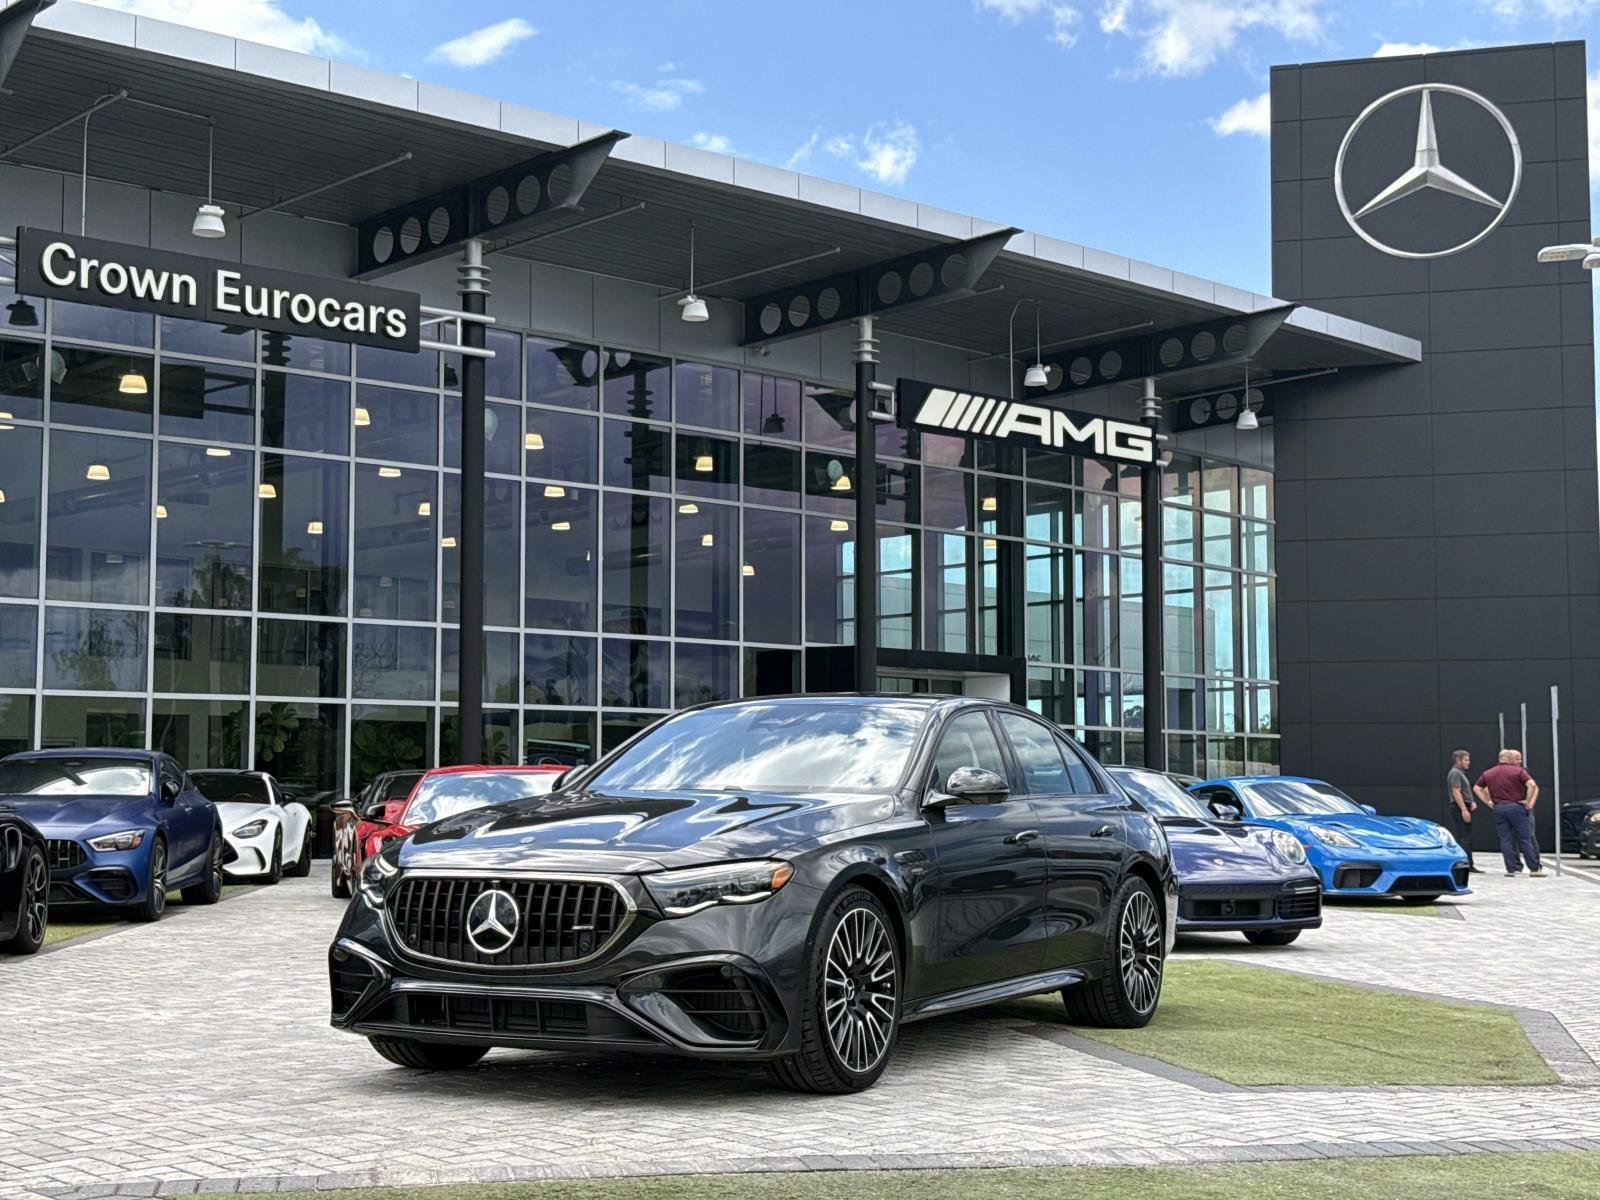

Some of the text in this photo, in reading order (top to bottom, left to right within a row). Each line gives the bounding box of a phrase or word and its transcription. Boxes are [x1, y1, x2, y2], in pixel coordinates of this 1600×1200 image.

[42, 242, 408, 338] Crown Eurocars
[995, 402, 1153, 463] AMG
